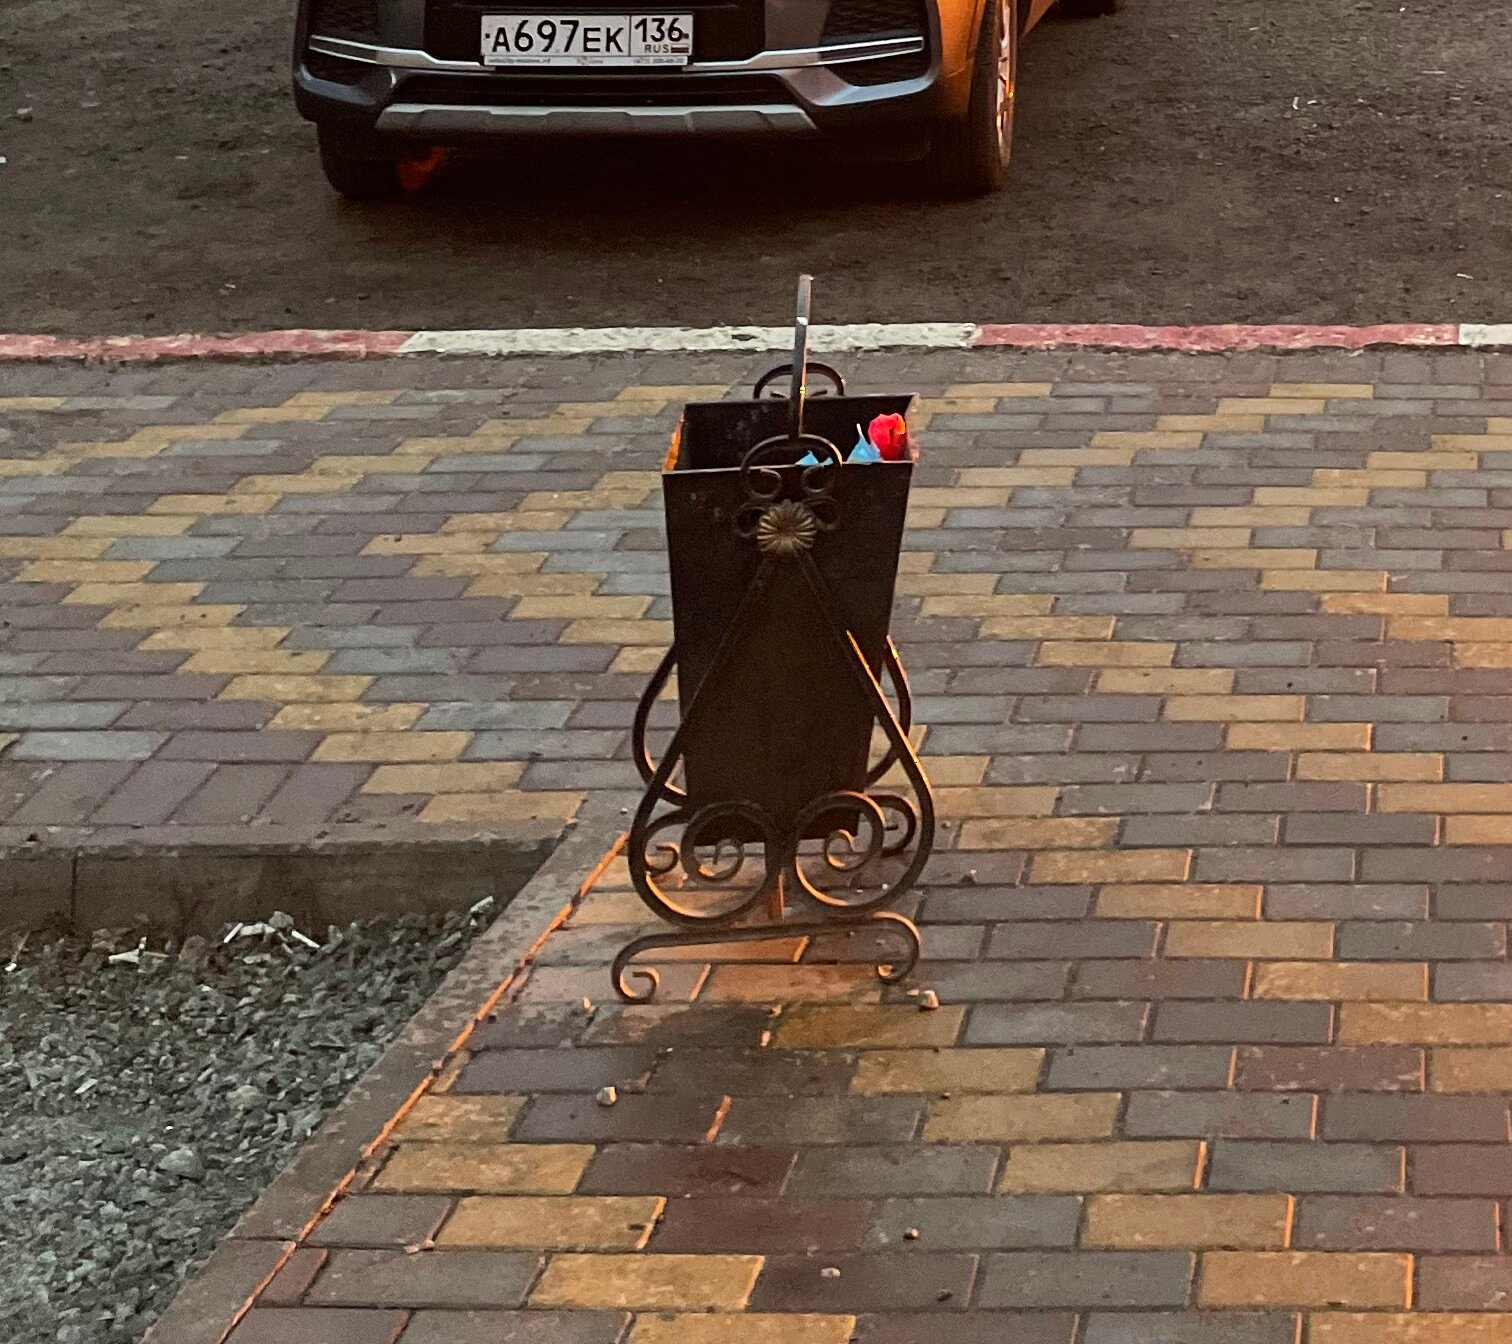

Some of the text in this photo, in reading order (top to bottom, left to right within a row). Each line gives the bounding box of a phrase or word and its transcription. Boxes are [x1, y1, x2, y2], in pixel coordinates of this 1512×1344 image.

[491, 17, 684, 53] А697ЕК 136
[644, 44, 670, 54] RUS
